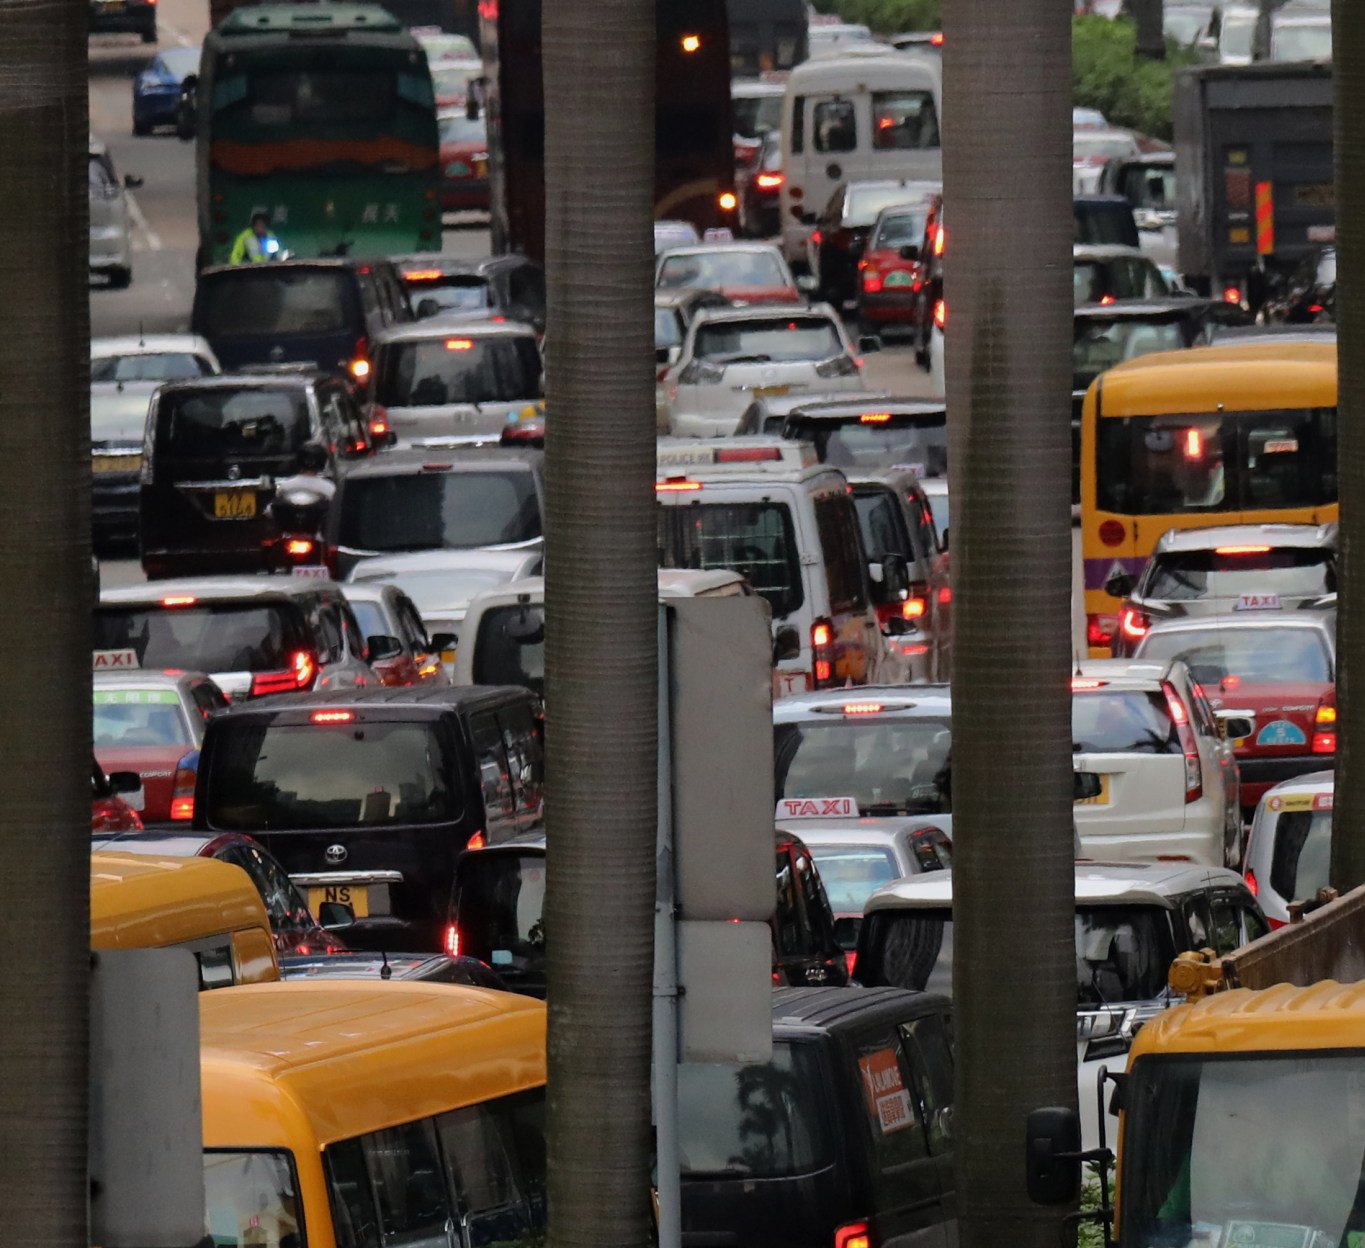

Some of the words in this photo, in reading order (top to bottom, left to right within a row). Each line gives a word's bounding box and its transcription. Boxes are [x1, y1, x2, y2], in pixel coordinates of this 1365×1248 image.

[1242, 596, 1278, 607] TAXI
[94, 652, 132, 668] AXI
[784, 800, 851, 816] TAXI
[325, 888, 351, 902] NS
